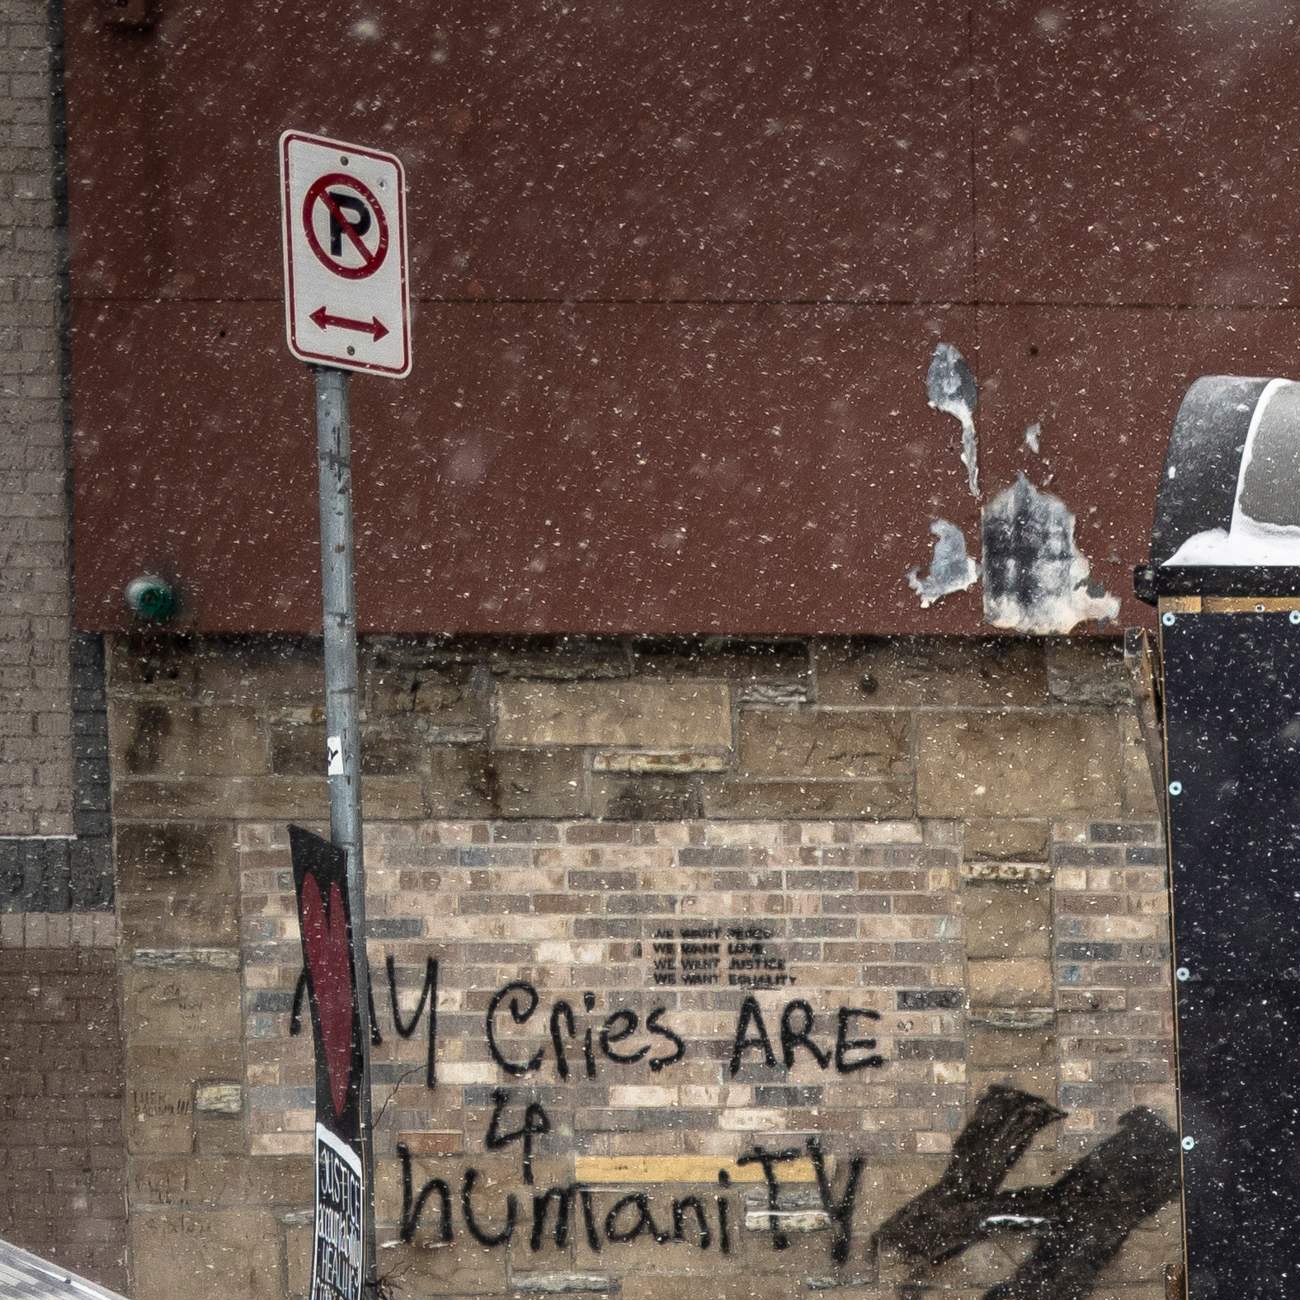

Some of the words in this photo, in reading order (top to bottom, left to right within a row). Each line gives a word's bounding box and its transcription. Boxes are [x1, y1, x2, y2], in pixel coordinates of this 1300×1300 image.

[653, 942, 675, 954] WE
[680, 942, 720, 955] WANT
[654, 958, 676, 970] WE
[680, 958, 721, 970] WANT
[728, 957, 786, 970] JUSTICE
[653, 973, 677, 985] WE
[681, 973, 720, 985] WANT
[728, 973, 797, 986] EQUALITY
[485, 980, 687, 1081] Cries
[730, 995, 885, 1078] ARE
[320, 1147, 361, 1231] JUSTICE
